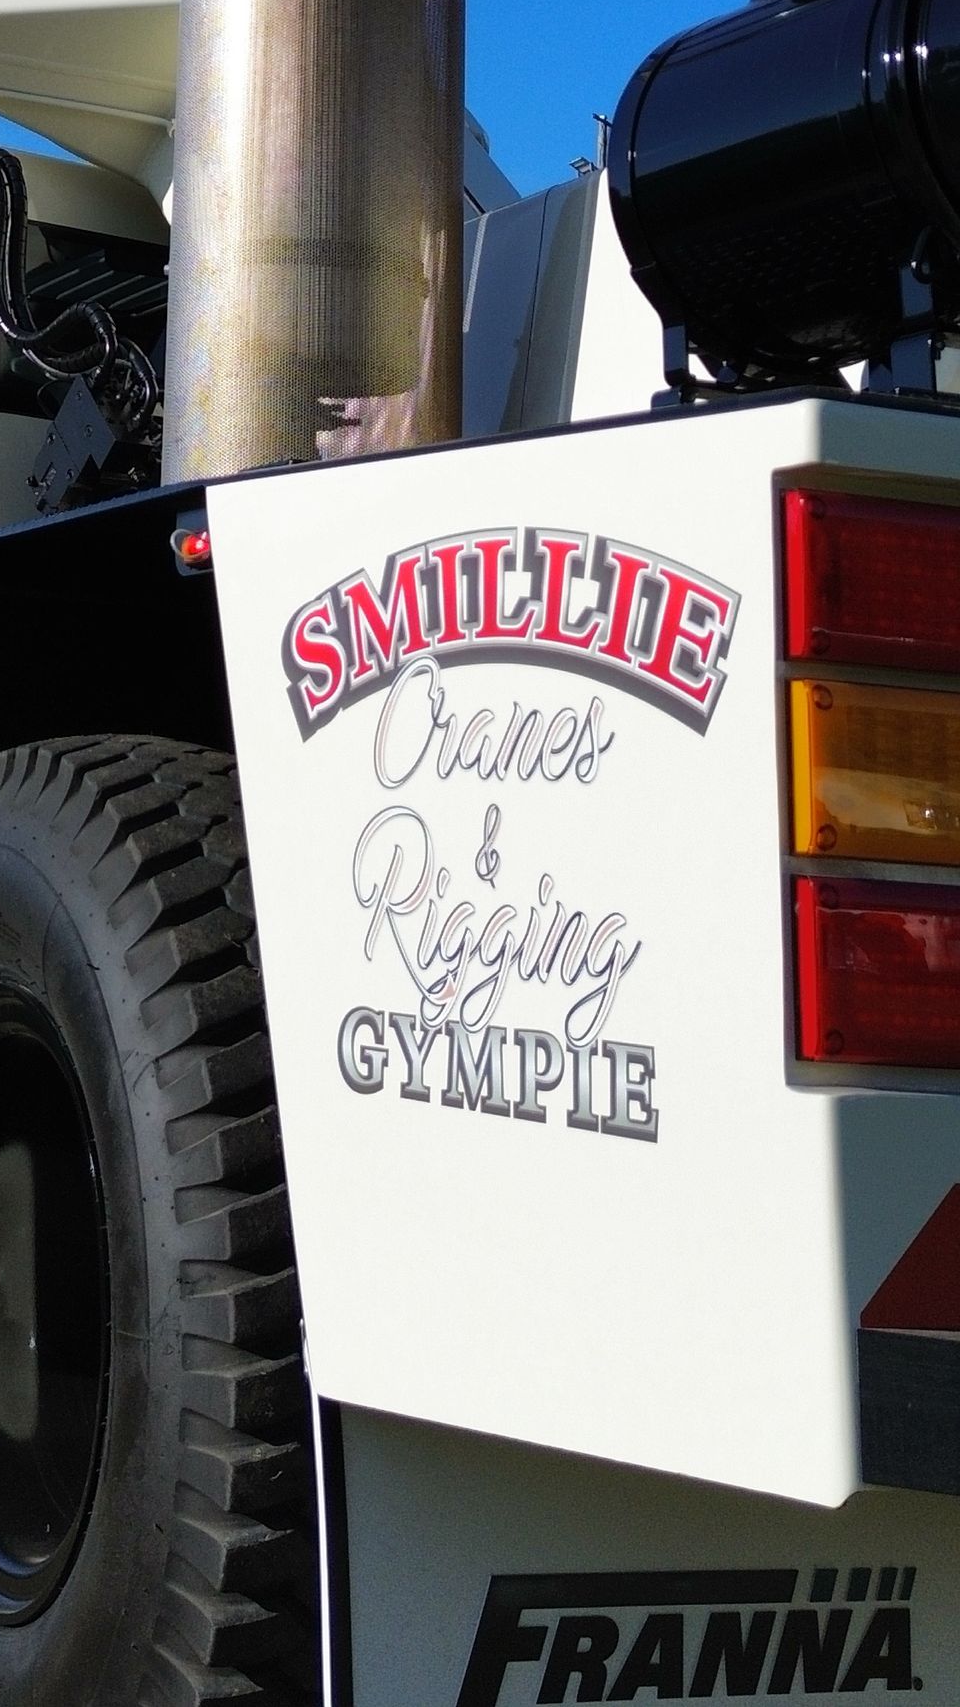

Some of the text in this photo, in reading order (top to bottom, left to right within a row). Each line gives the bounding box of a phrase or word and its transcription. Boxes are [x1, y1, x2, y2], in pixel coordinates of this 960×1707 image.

[282, 525, 742, 742] SMILLIE
[374, 655, 616, 789] Cranes
[475, 803, 500, 889] &
[352, 805, 642, 1047] Rigging
[337, 1005, 659, 1144] GYMPIE
[454, 1566, 917, 1707] FRANNA
